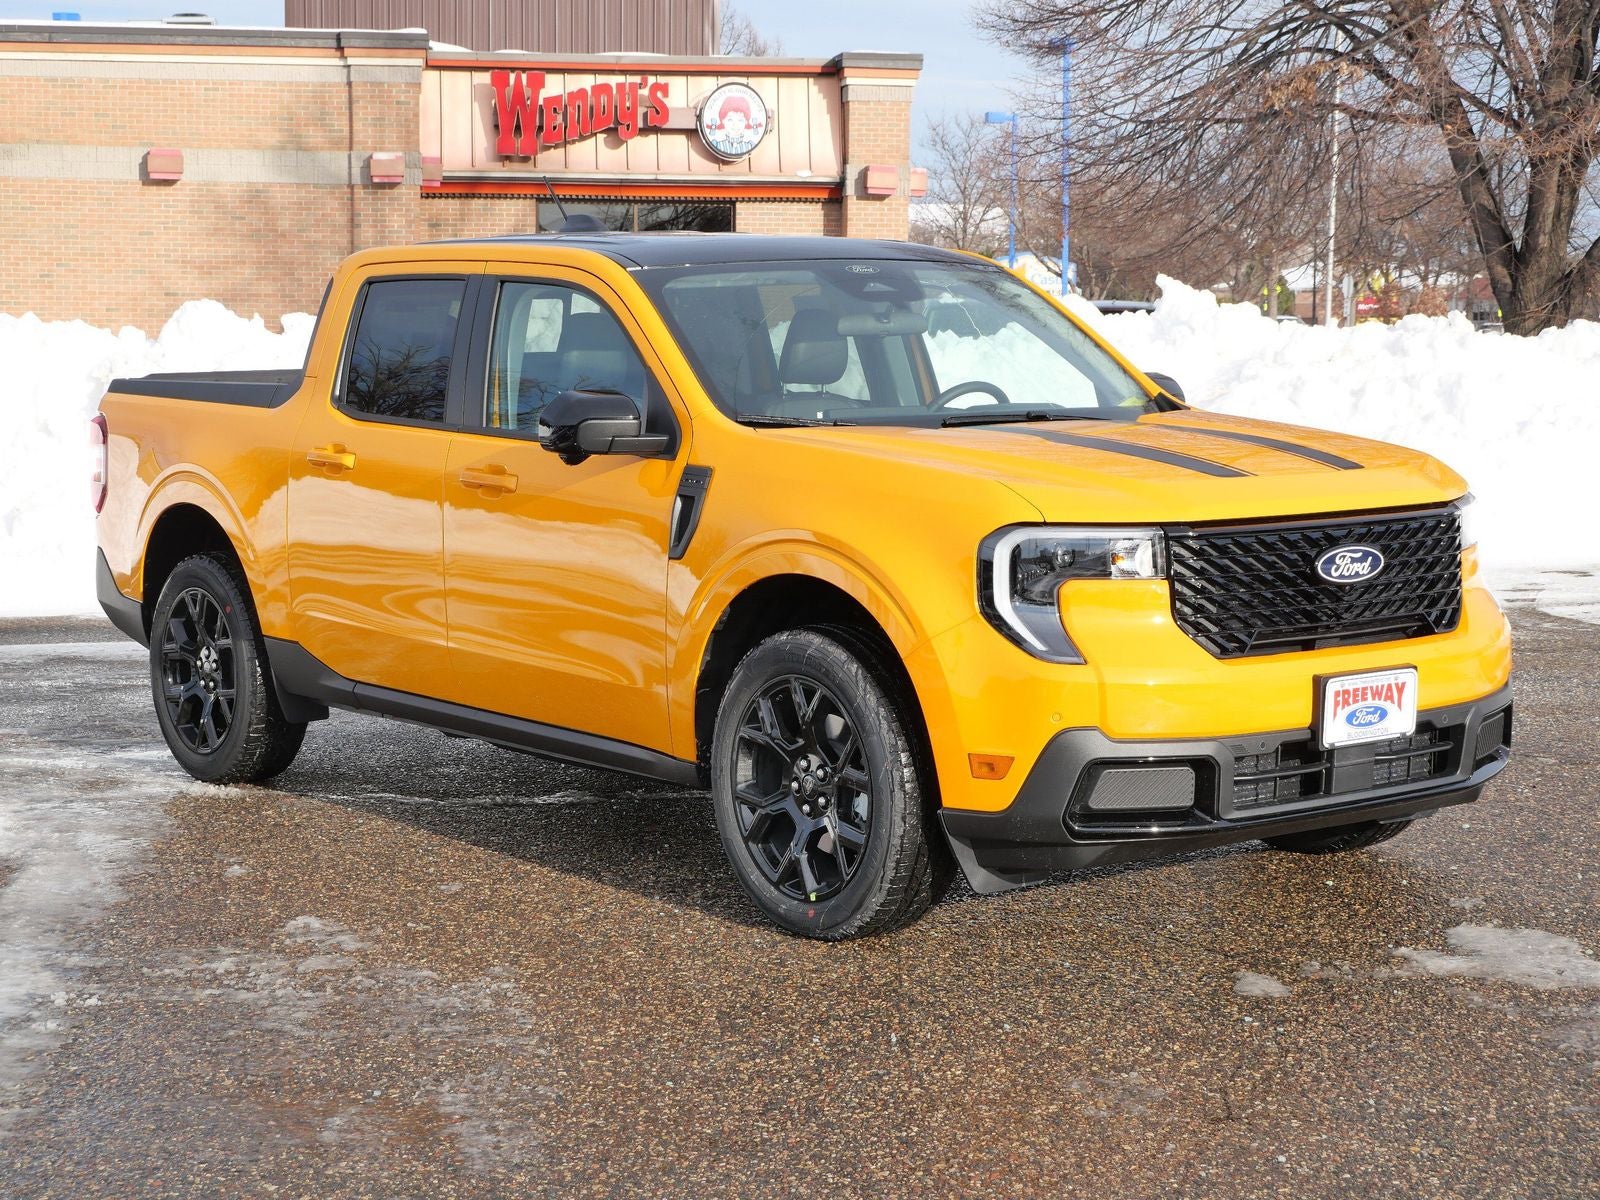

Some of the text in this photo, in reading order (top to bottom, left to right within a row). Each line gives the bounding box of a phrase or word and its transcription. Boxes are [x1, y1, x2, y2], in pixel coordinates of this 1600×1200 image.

[1031, 272, 1060, 286] Cast
[1331, 552, 1372, 577] Ford
[1333, 682, 1406, 721] FREEWAY
[1353, 707, 1380, 725] Ford
[1347, 728, 1389, 739] BLOOMINGTON
